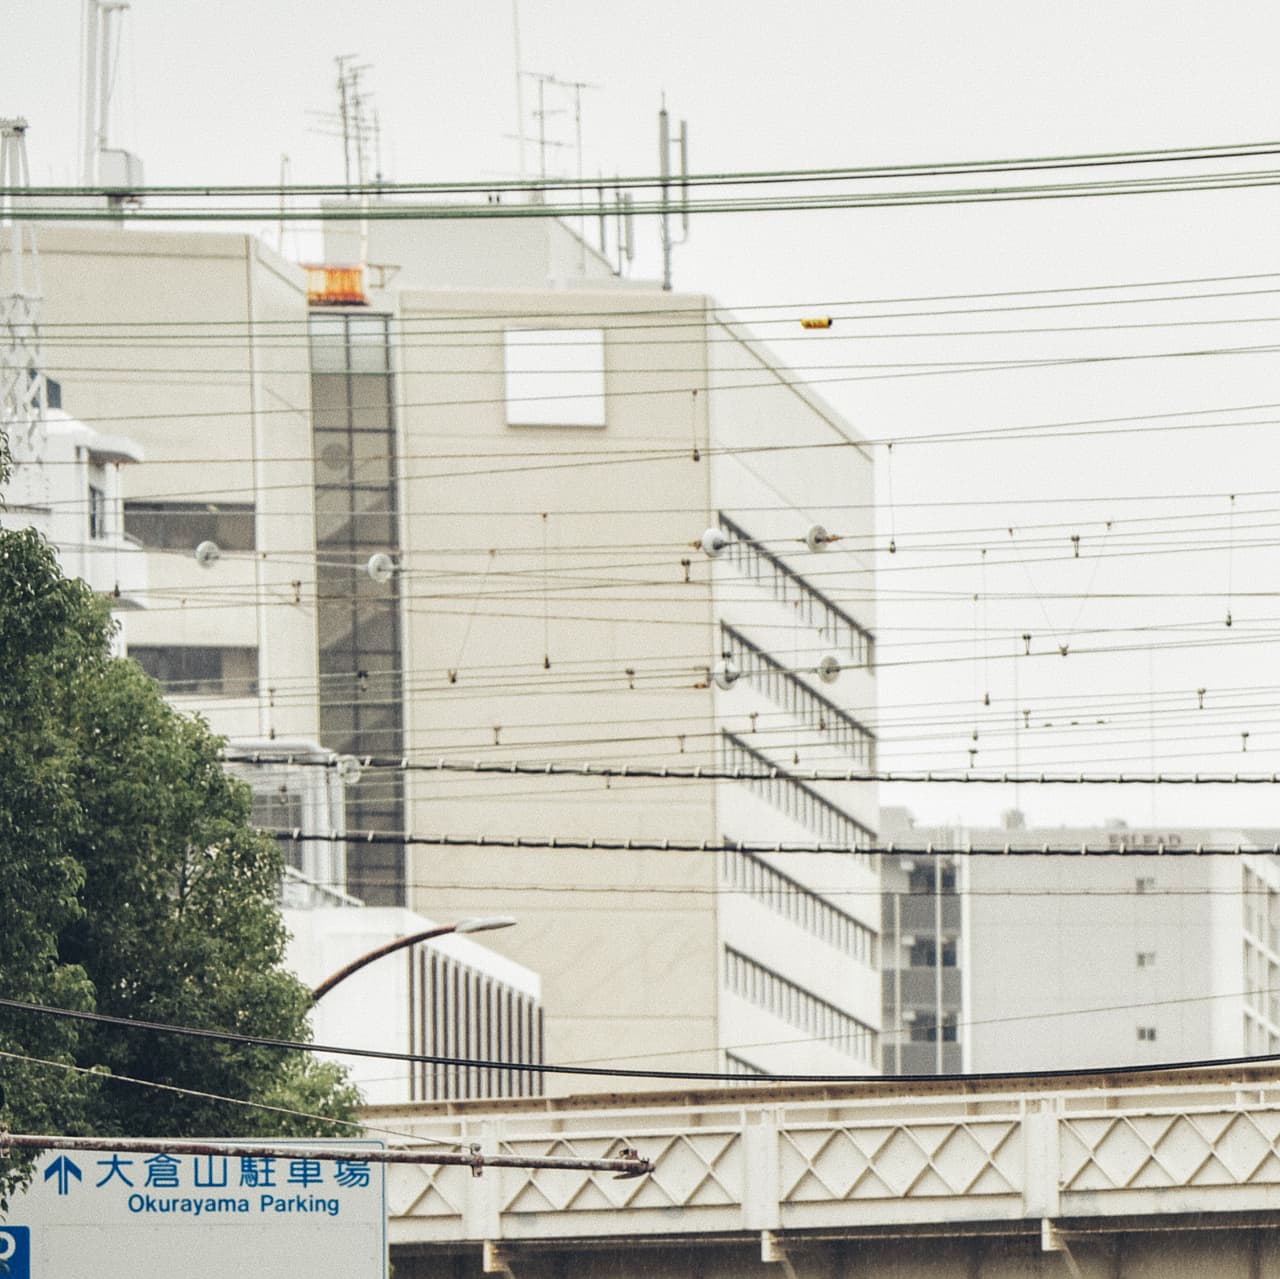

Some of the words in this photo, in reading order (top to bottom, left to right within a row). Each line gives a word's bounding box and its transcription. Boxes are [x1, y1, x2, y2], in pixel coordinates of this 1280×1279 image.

[96, 1153, 371, 1188] 大倉山駐車場
[128, 1195, 249, 1215] Okurayama
[260, 1194, 339, 1215] Parking
